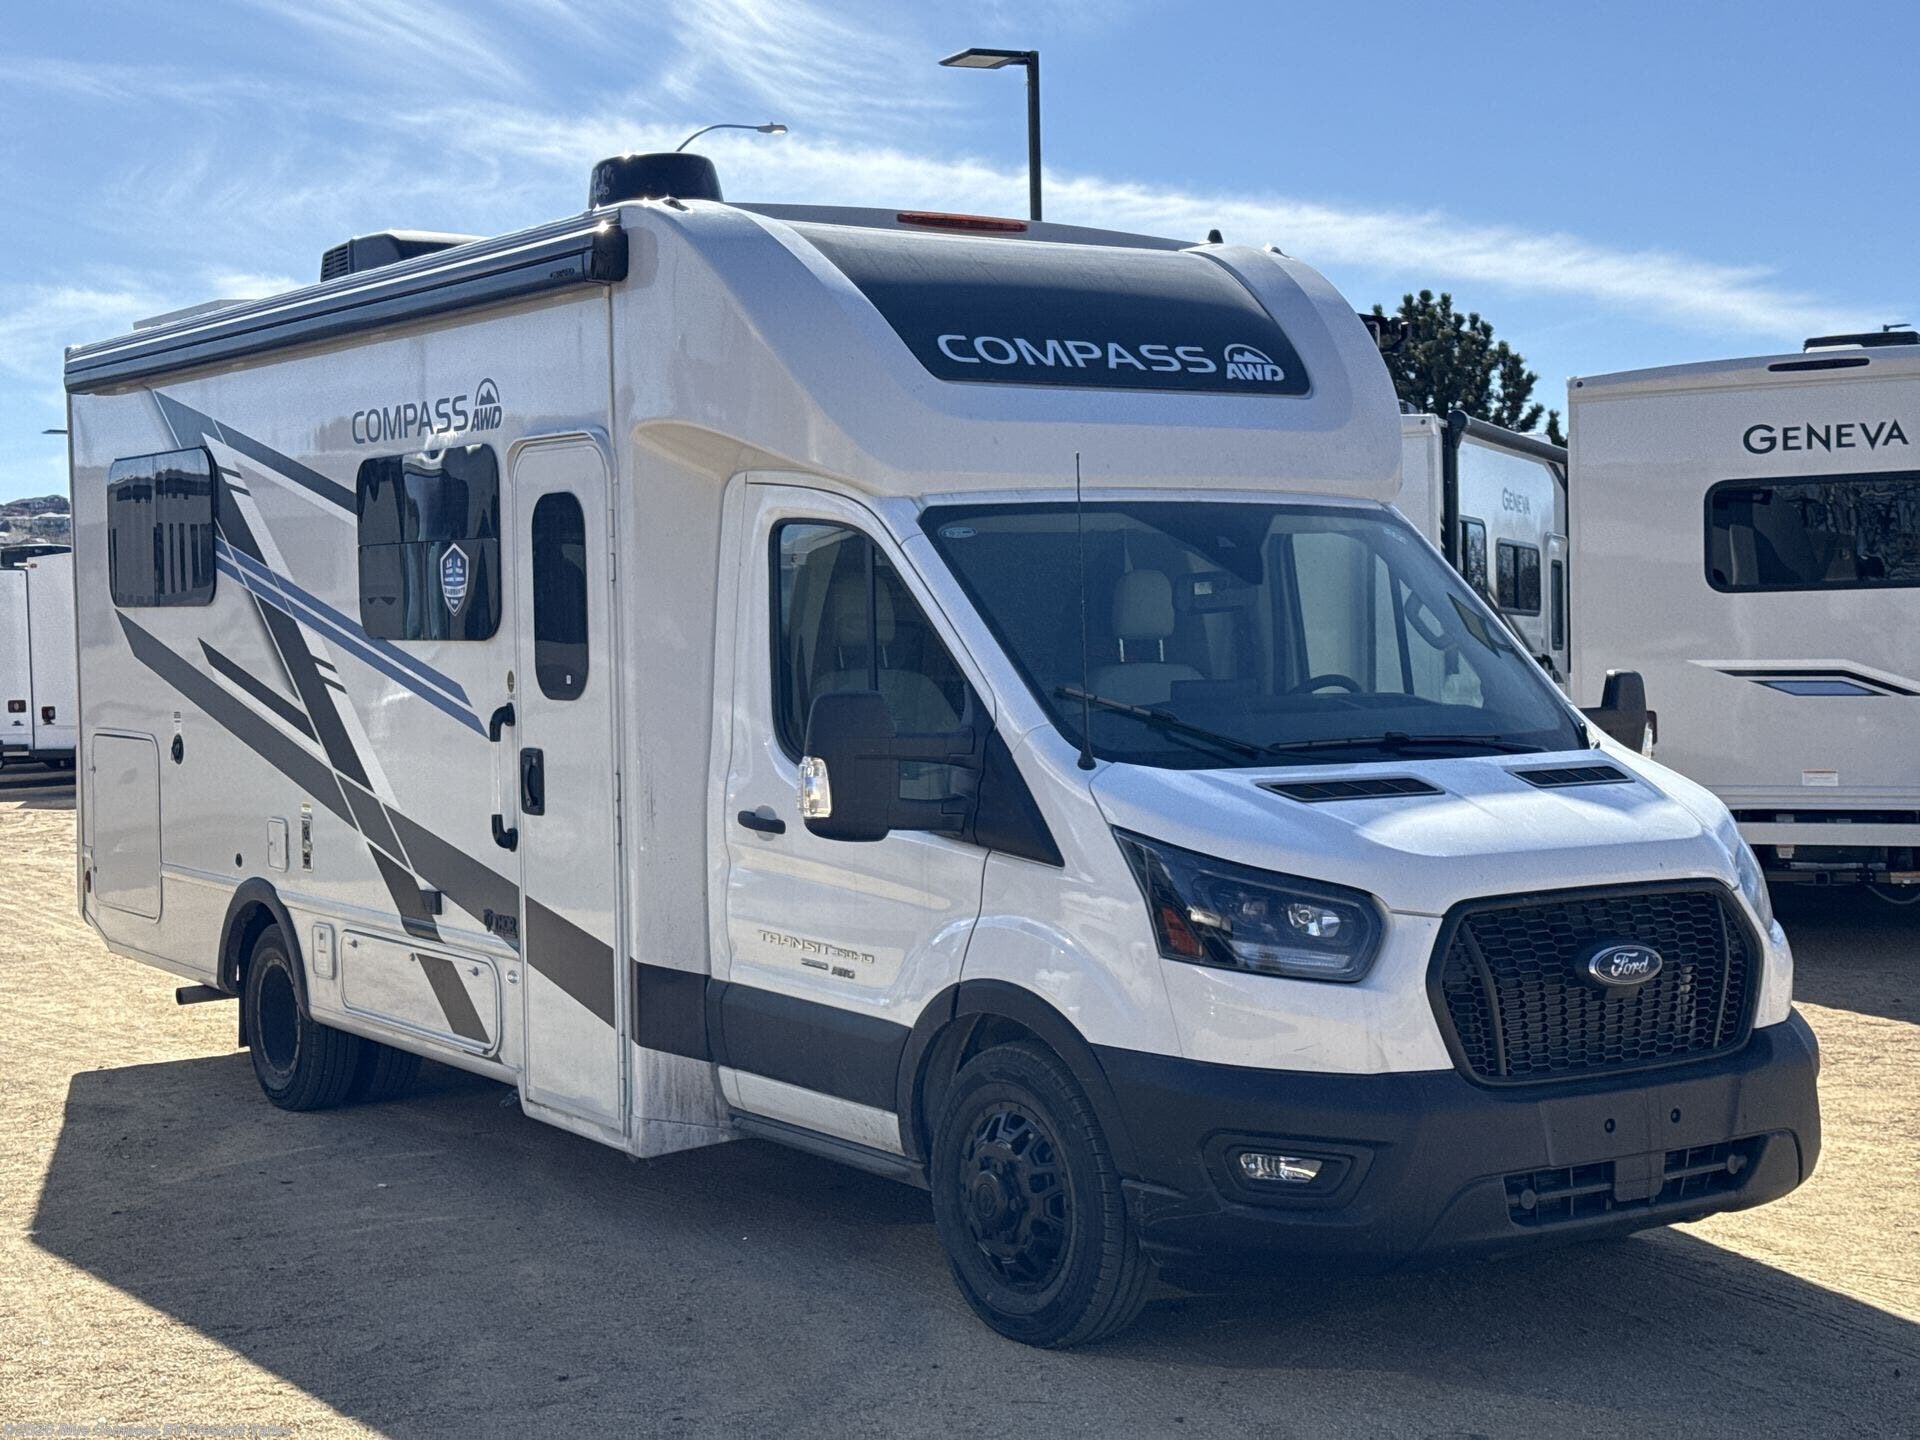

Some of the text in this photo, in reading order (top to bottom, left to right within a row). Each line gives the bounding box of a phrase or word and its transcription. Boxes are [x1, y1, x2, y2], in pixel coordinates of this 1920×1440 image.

[936, 334, 1286, 382] COMPASS AWD
[352, 394, 502, 444] COMPASS AWD
[1742, 417, 1909, 454] GENEVA
[1502, 487, 1531, 516] GENEVA
[1610, 951, 1650, 977] Ford
